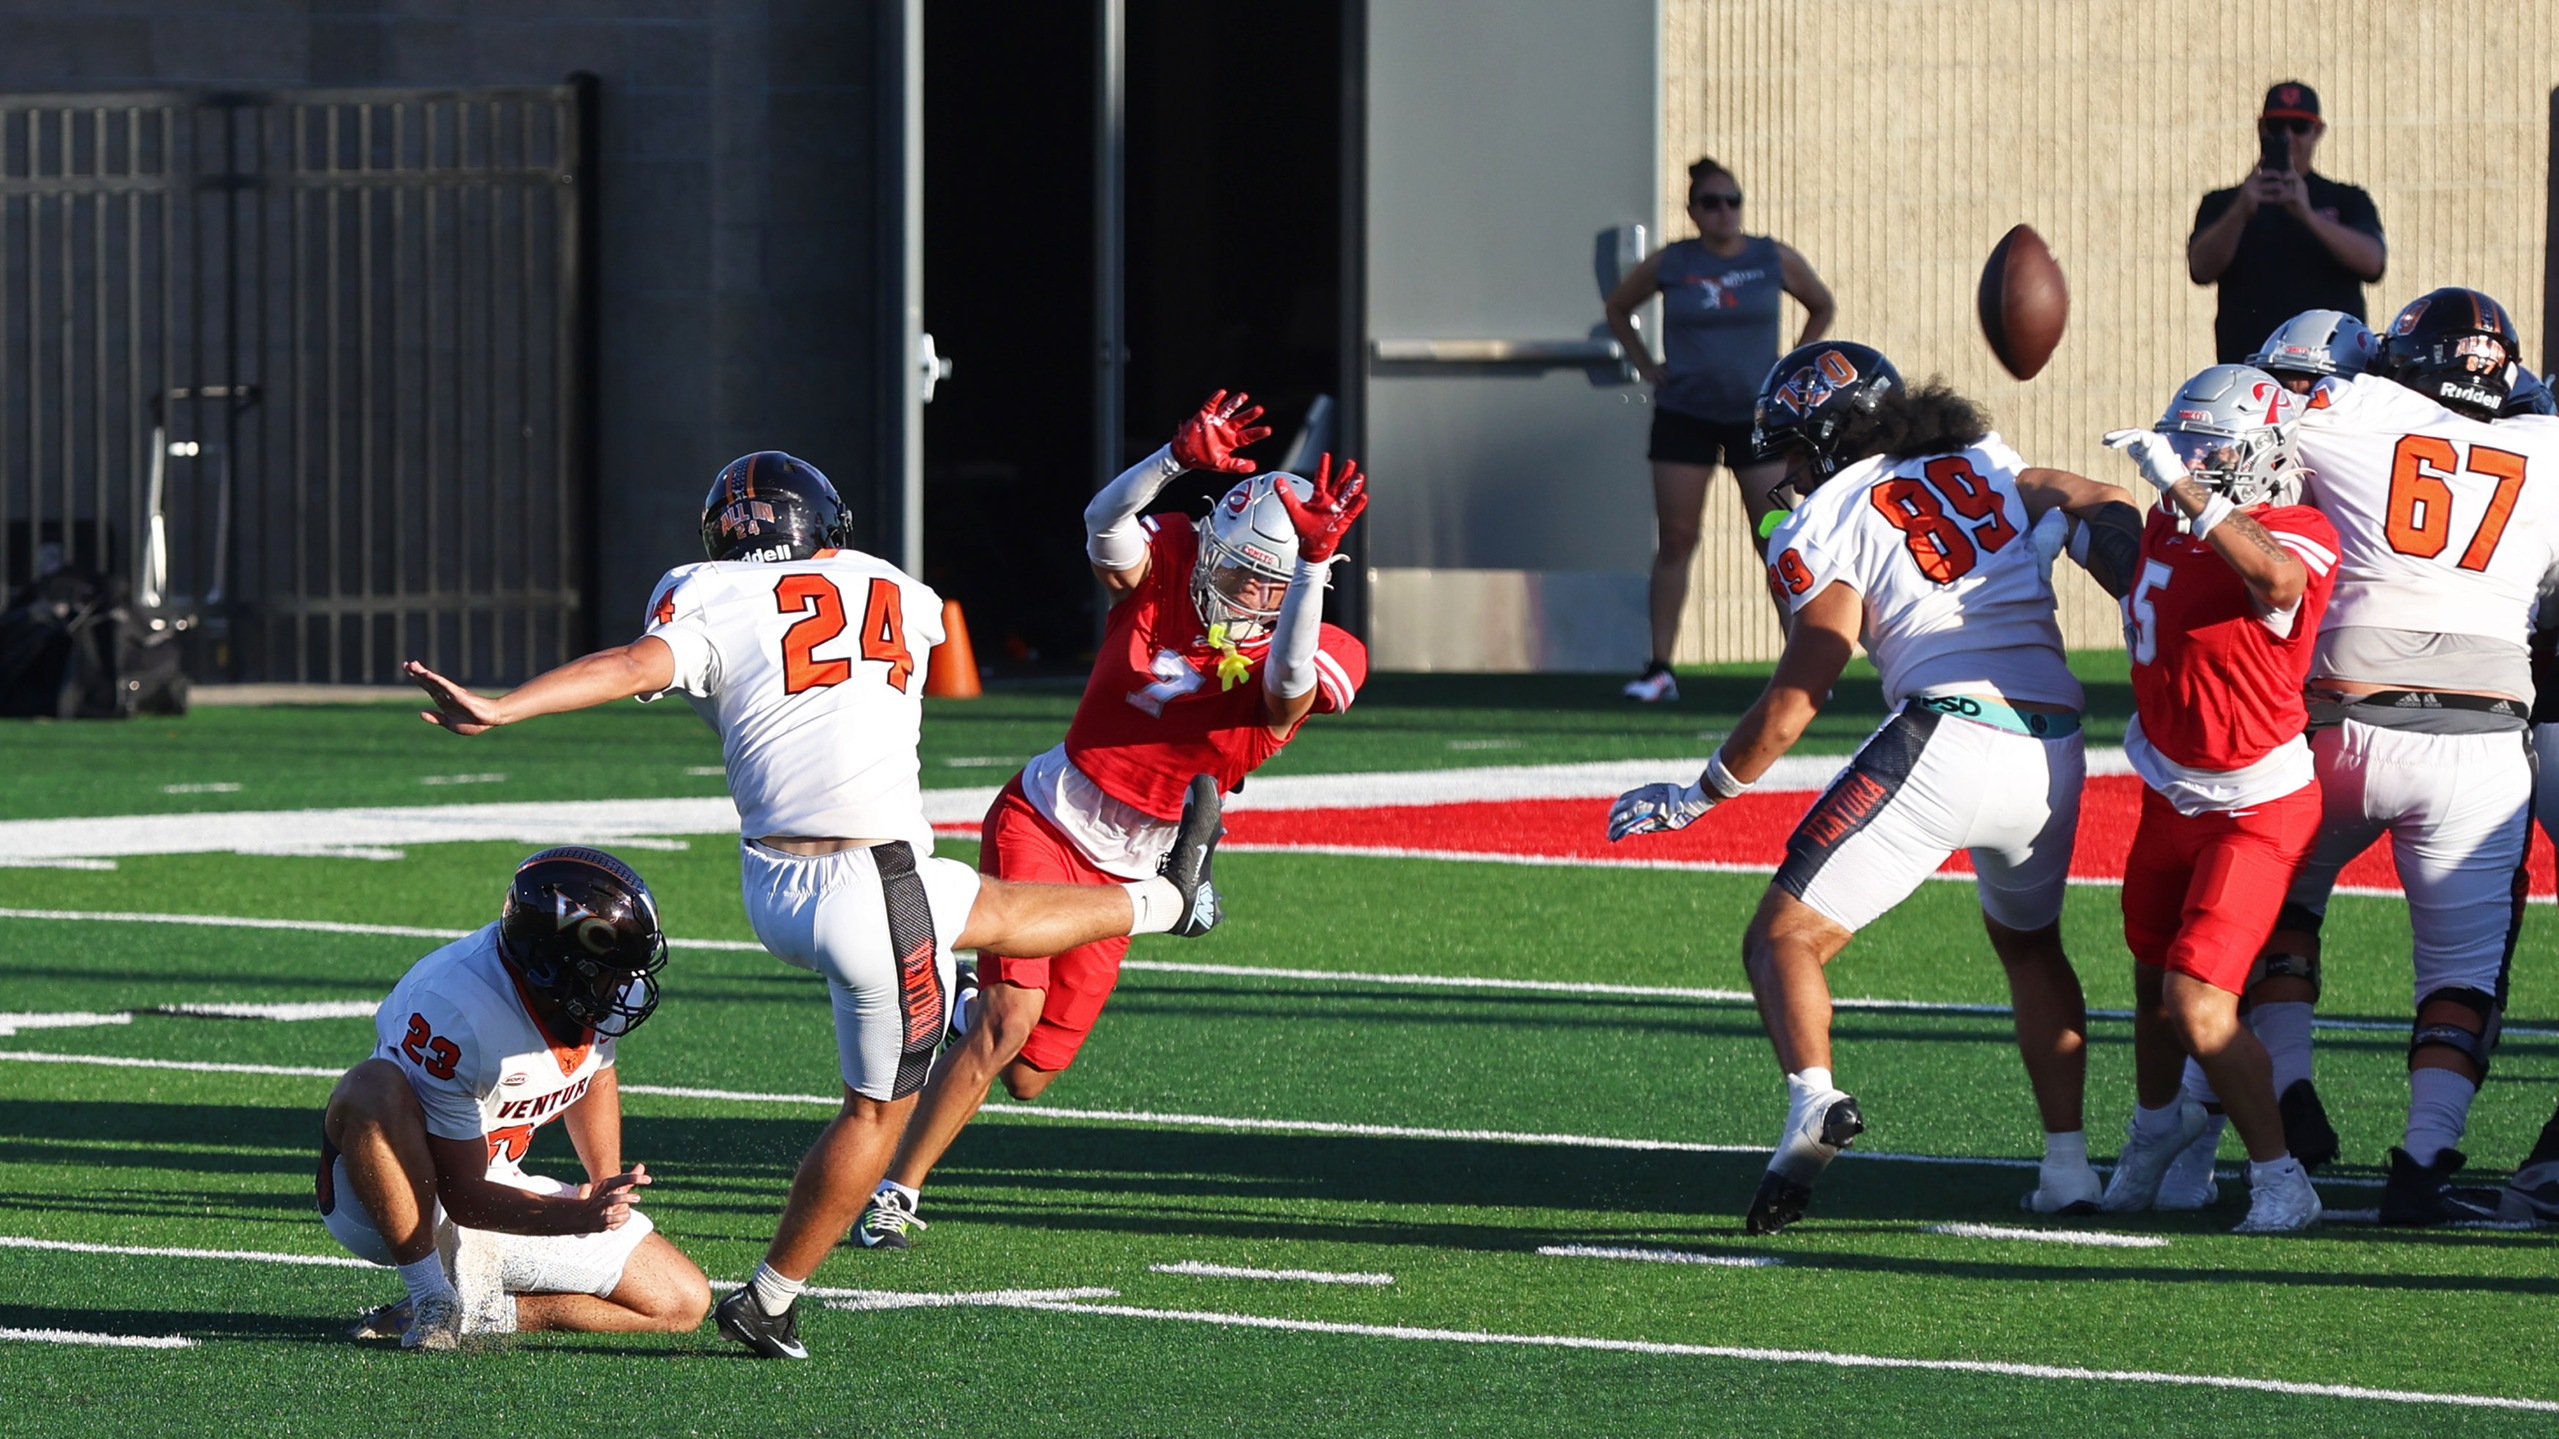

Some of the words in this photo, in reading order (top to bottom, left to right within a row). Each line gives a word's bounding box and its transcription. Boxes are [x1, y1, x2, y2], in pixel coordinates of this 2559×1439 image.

[2440, 382, 2502, 410] Riddell
[720, 502, 750, 537] ALL
[750, 501, 775, 523] IN
[734, 519, 760, 540] 24
[1871, 456, 2018, 585] 89
[2384, 434, 2528, 572] 67
[773, 573, 914, 695] 24
[2134, 557, 2173, 665] 5
[1803, 772, 1886, 848] VENTURA
[903, 937, 941, 1044] VENTURA
[401, 1012, 462, 1081] 23
[497, 1075, 589, 1119] VENTUR
